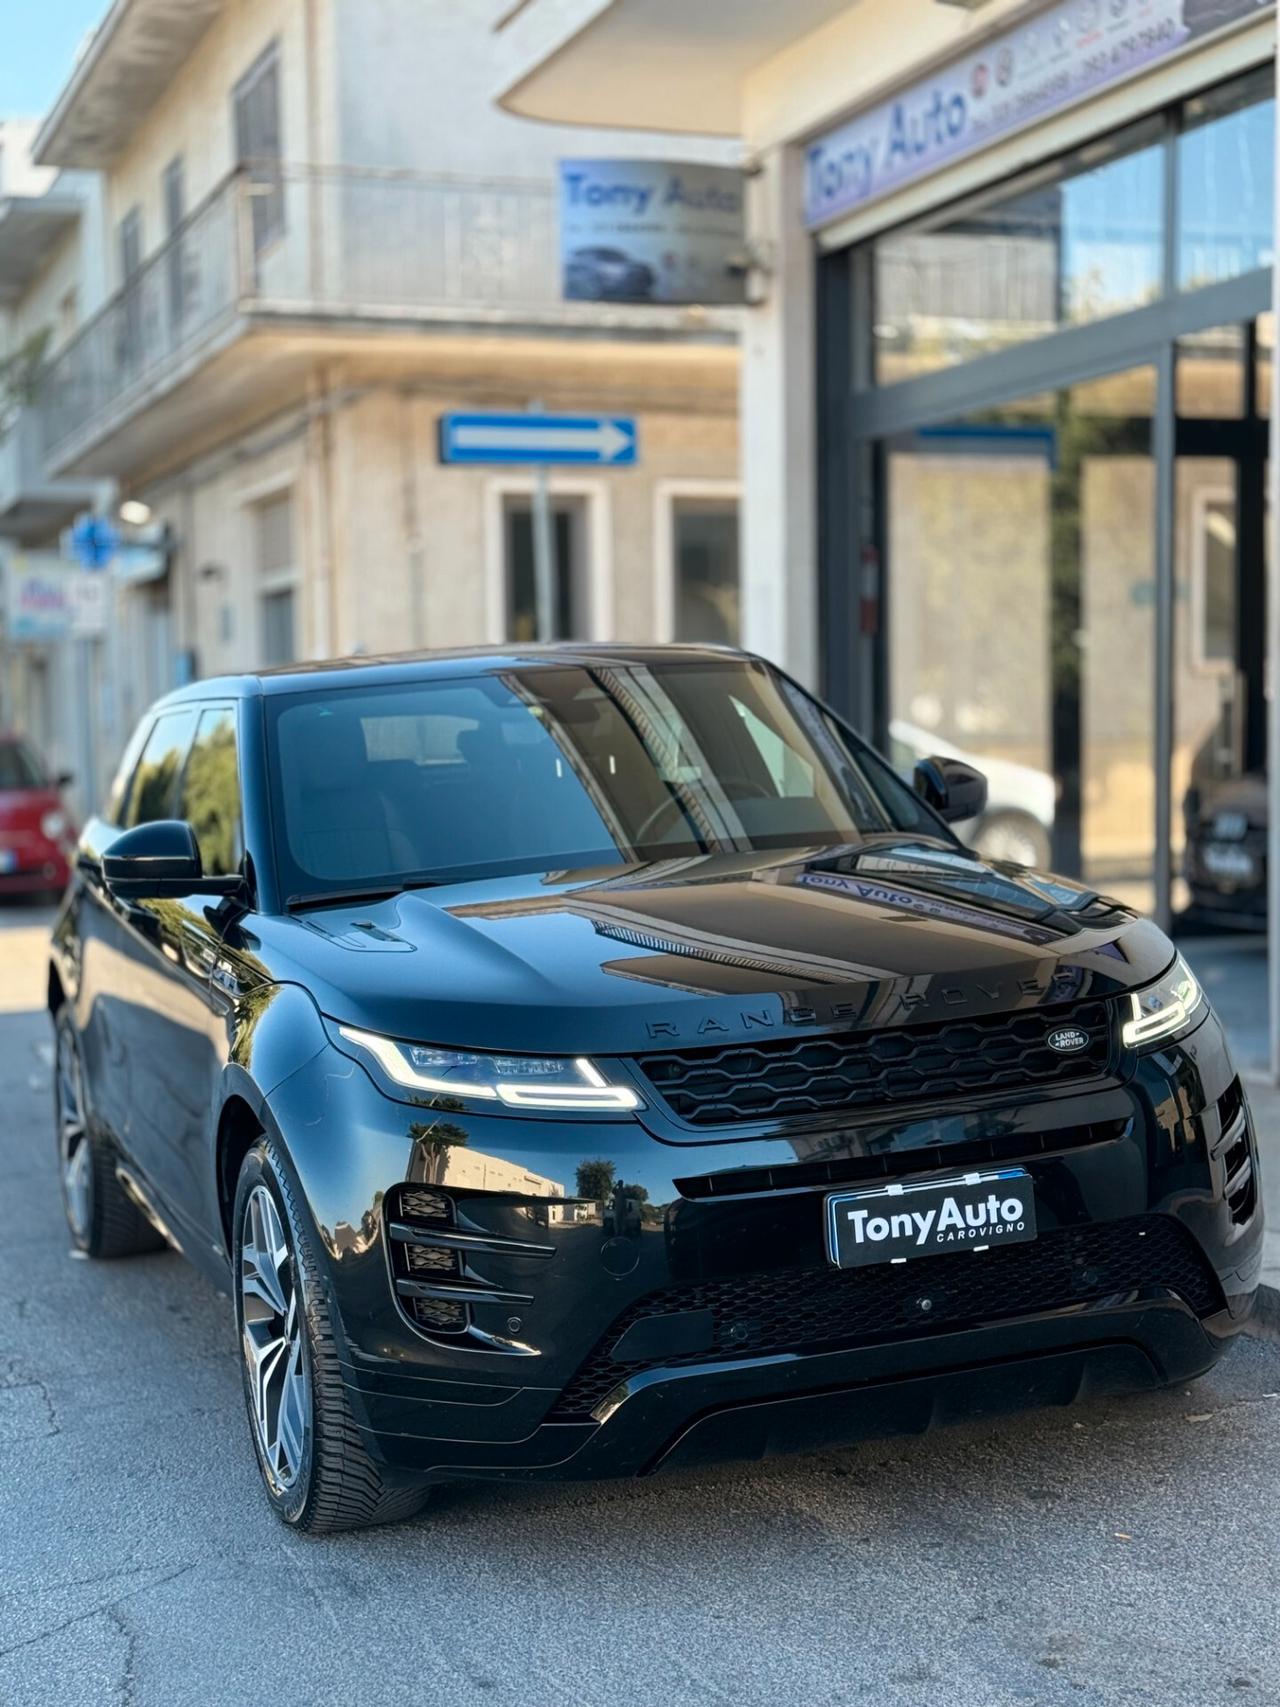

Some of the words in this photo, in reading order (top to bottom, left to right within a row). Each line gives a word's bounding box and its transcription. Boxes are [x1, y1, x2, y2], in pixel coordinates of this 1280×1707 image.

[809, 137, 877, 206] Tony
[884, 88, 966, 172] Auto
[563, 172, 653, 215] Tony
[1055, 1031, 1076, 1041] LAND
[1060, 1037, 1084, 1048] ROVER
[847, 1194, 1024, 1246] TonyAuto
[936, 1221, 1026, 1244] CAROVIGNO
